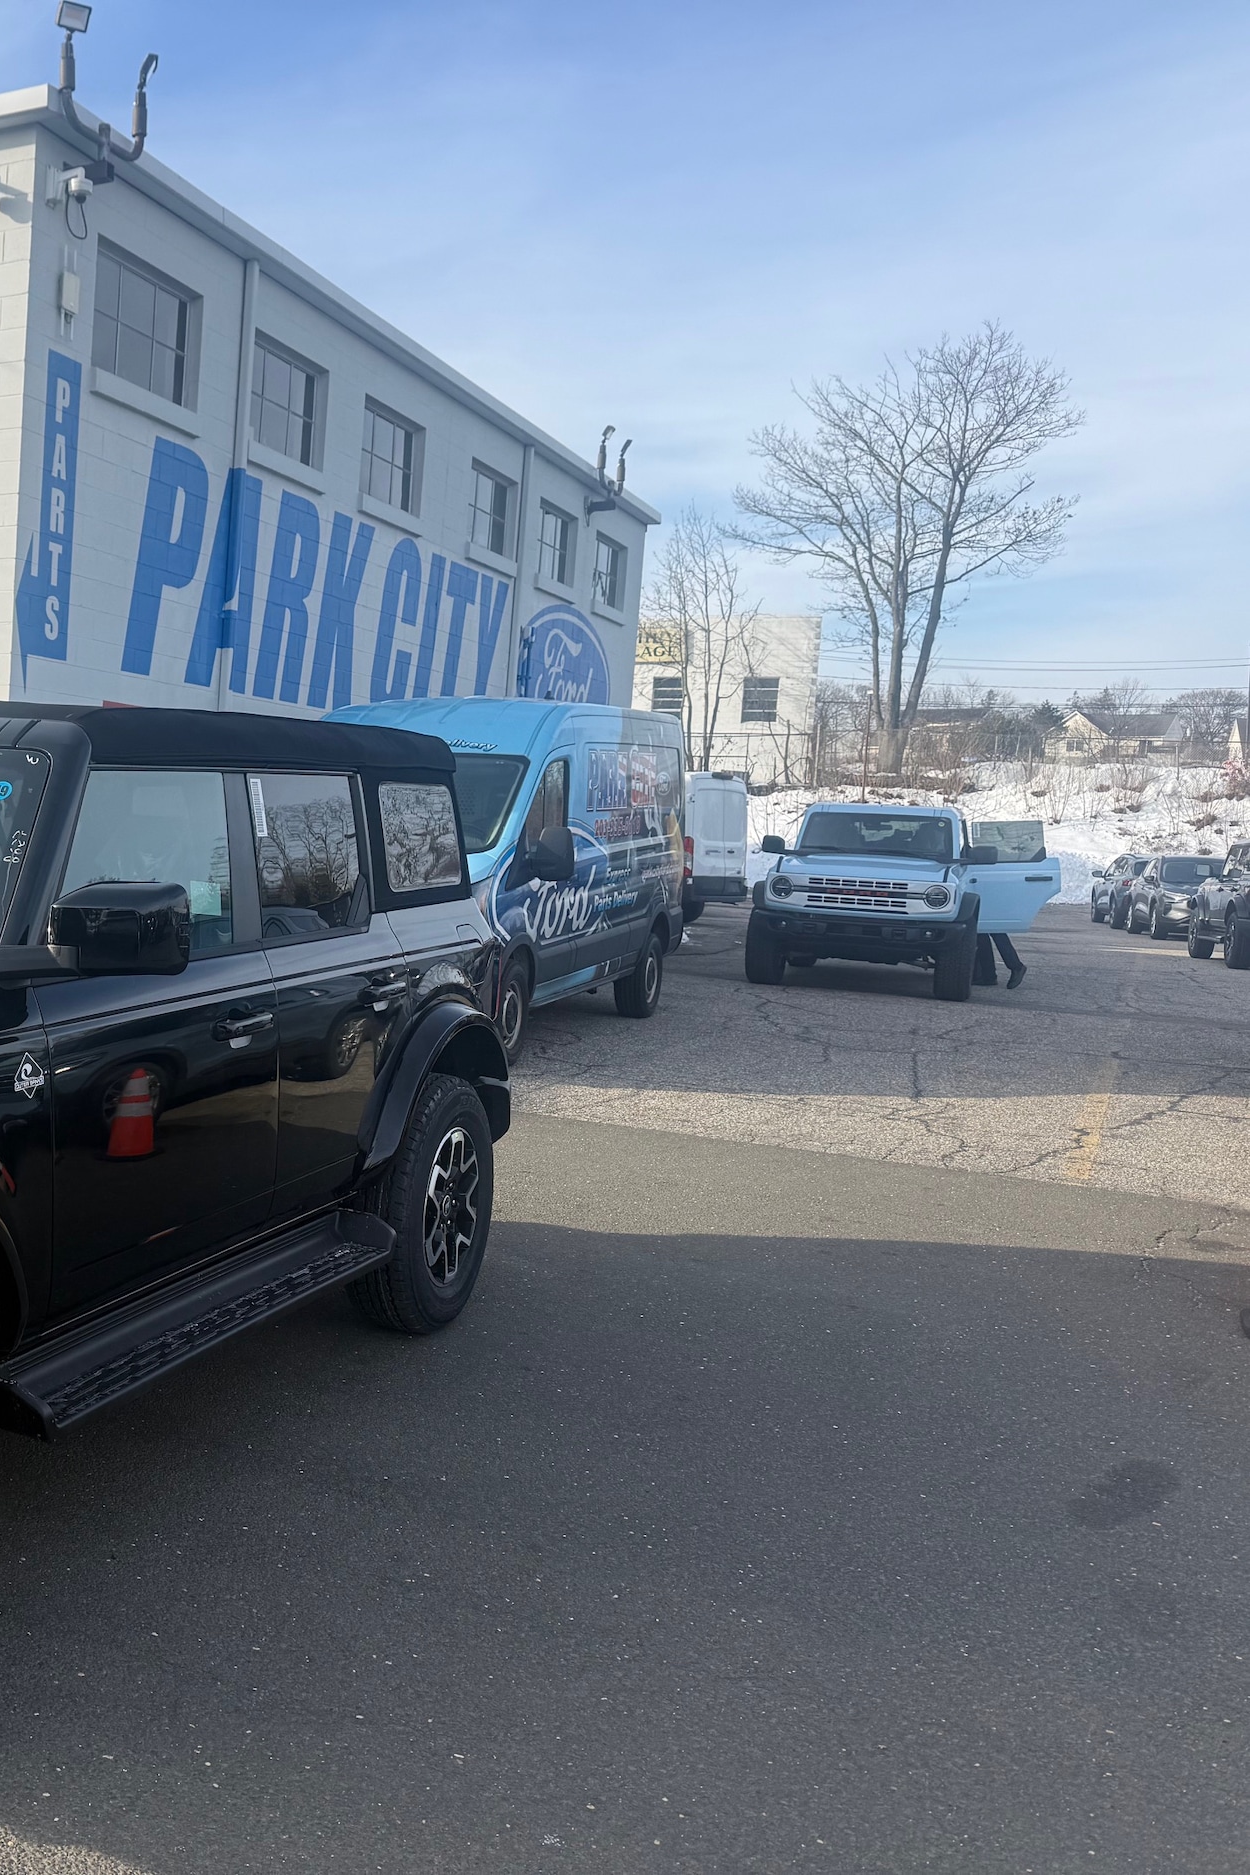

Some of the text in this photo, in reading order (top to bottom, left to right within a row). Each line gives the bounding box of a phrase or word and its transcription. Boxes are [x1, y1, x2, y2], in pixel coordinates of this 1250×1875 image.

[44, 377, 71, 642] PARTS
[120, 436, 509, 710] PARK CITY
[523, 865, 597, 943] Ford
[594, 889, 638, 912] Parts Delivery
